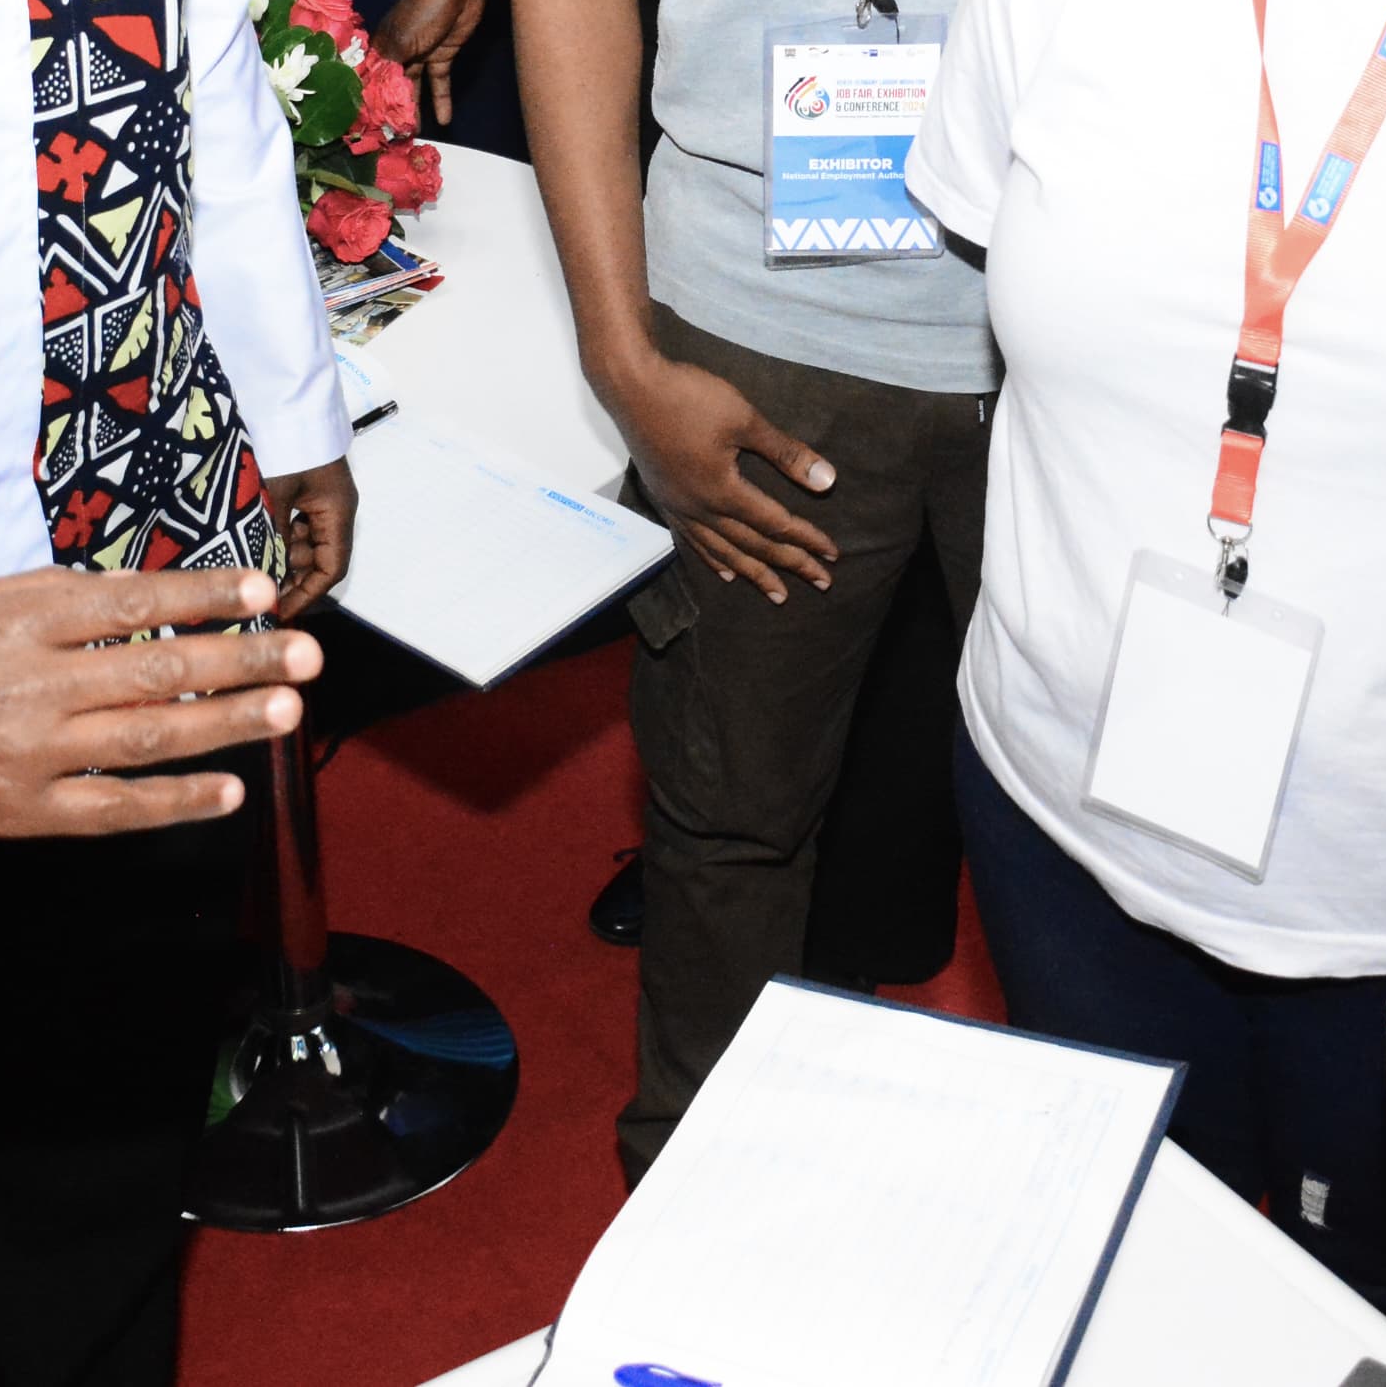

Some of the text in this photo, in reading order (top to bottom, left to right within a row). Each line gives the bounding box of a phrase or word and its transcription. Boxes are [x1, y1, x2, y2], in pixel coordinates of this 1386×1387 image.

[836, 88, 851, 99] JOB
[877, 88, 926, 99] EXHIBITION
[835, 101, 842, 113] &
[843, 101, 900, 112] CONFERENCE
[809, 158, 893, 170] EXHIBITOR
